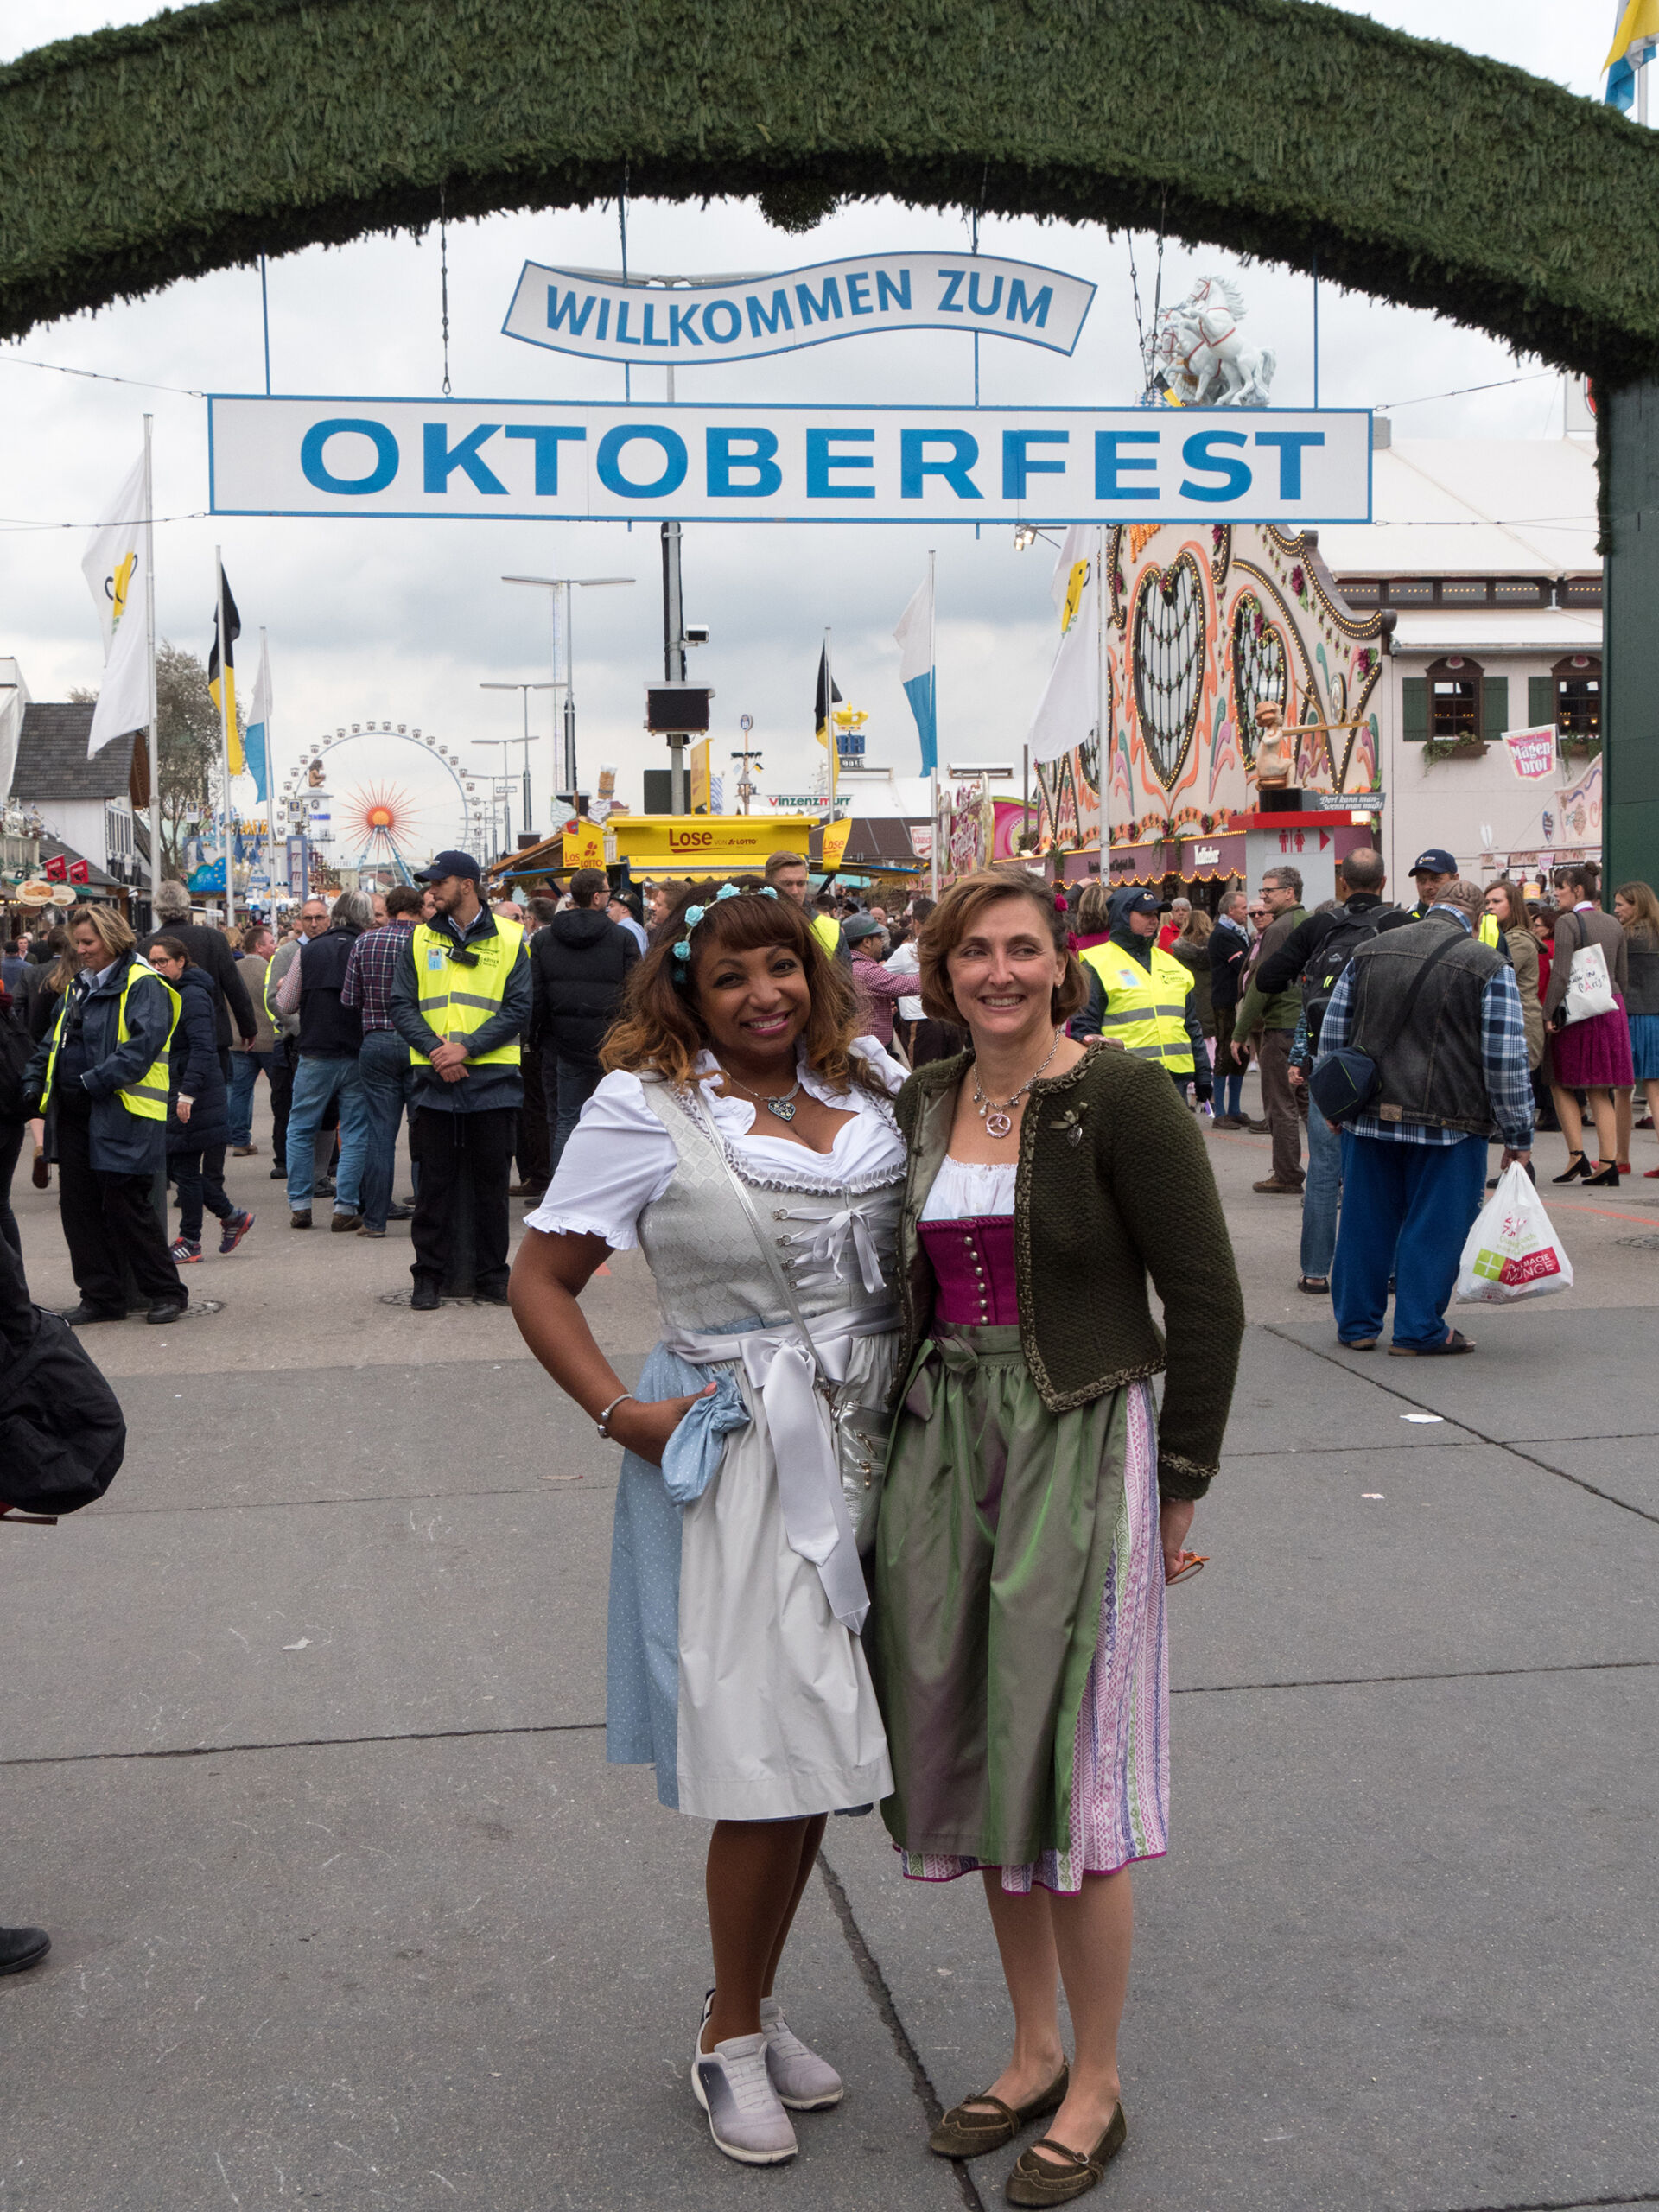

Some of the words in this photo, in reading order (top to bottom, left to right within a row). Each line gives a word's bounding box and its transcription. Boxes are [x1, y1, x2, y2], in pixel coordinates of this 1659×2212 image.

[547, 269, 912, 346] WILLKOMMEN
[938, 269, 1054, 328] ZUM
[300, 417, 1325, 503] OKTOBERFEST
[1511, 742, 1554, 761] Magen-
[1520, 757, 1548, 775] brot
[1338, 794, 1358, 804] kann
[669, 827, 713, 847] Lose
[823, 838, 845, 850] Lose
[564, 850, 580, 863] Los
[580, 859, 603, 869] LOTTO
